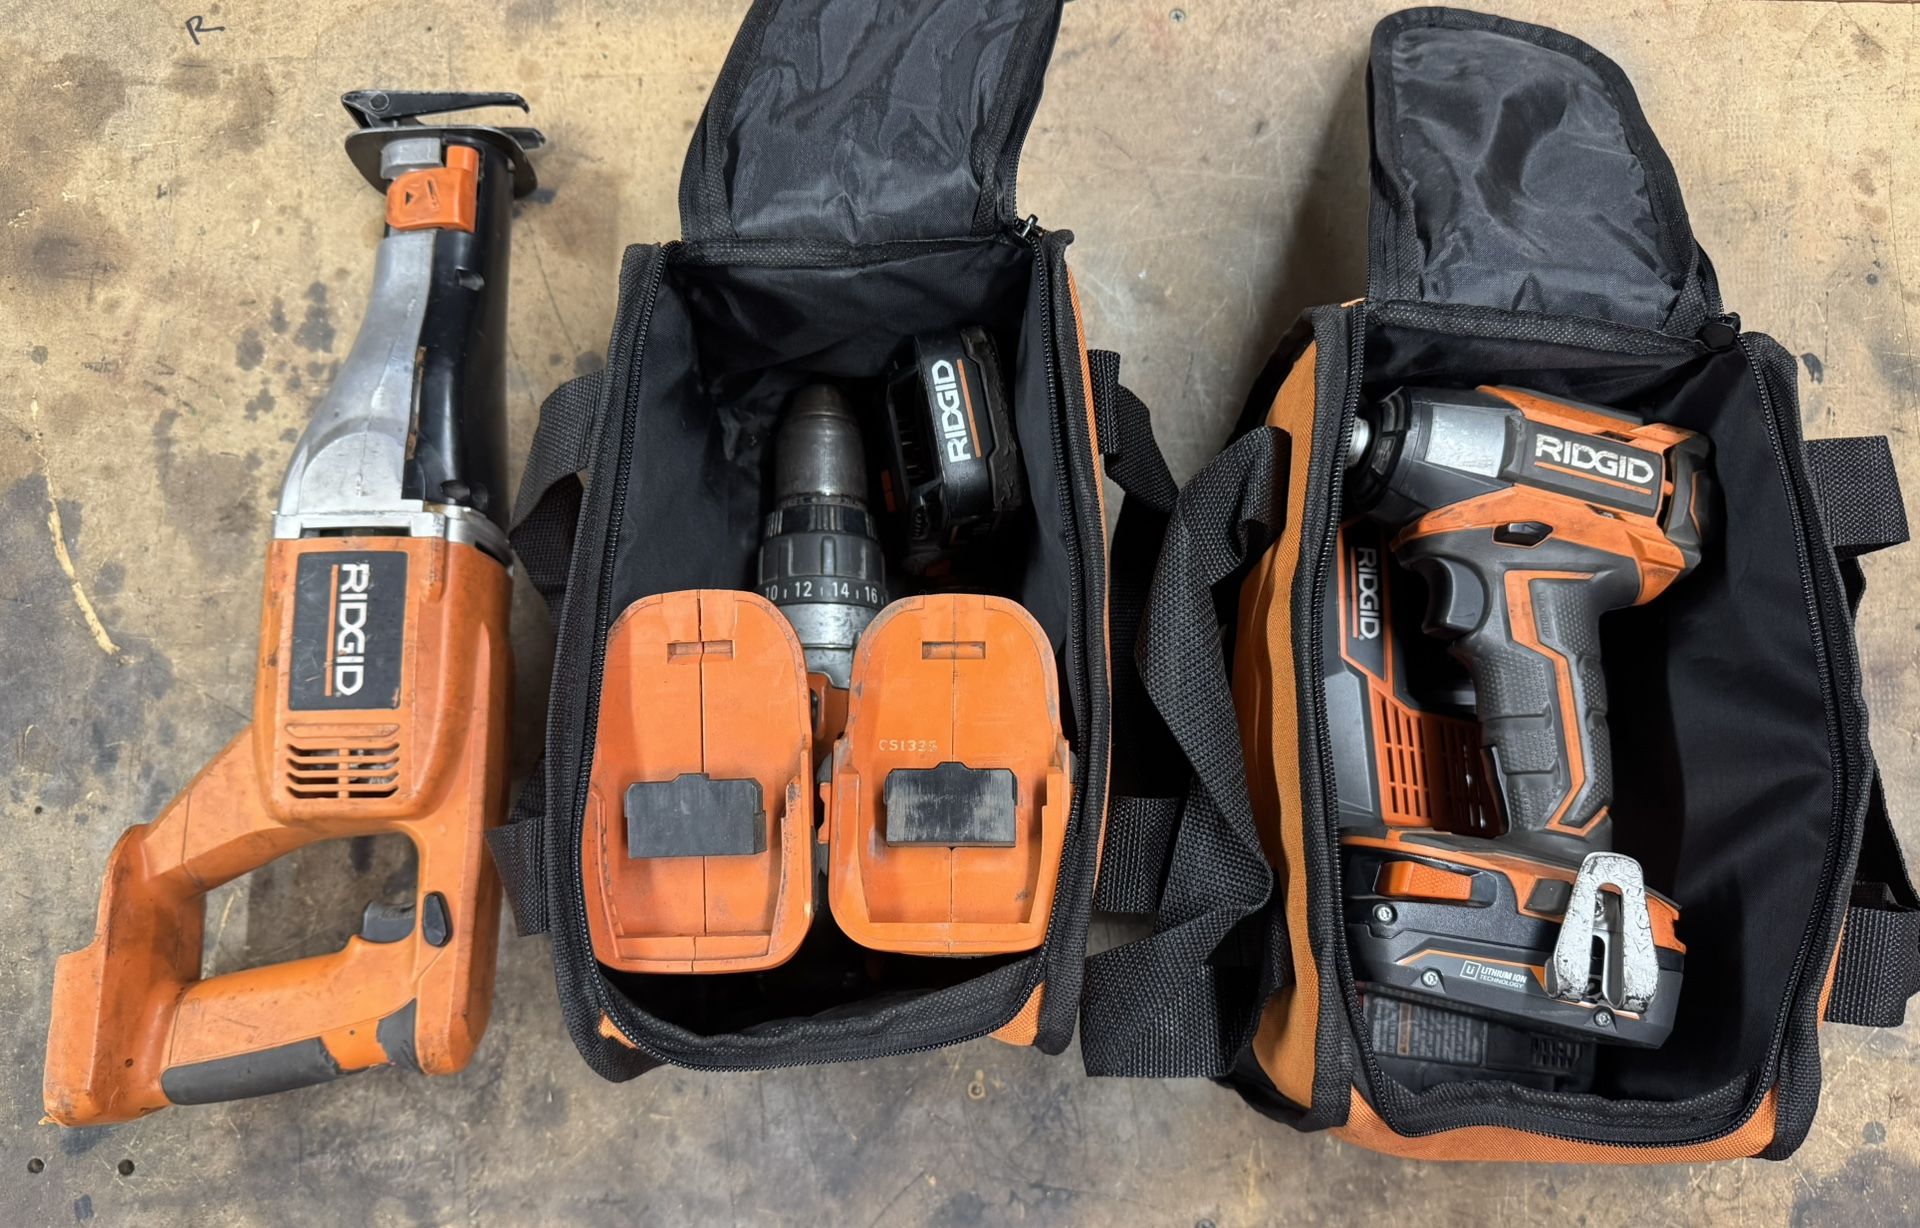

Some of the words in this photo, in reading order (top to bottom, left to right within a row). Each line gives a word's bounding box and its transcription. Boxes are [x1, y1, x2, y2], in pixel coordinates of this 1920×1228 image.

[184, 15, 225, 45] R
[932, 359, 971, 463] RIDGID
[1534, 433, 1654, 484] RIDGID
[765, 585, 778, 601] 10
[795, 581, 813, 598] 12
[831, 581, 850, 598] 14
[864, 586, 878, 604] 16
[1358, 548, 1380, 640] RIDGID
[335, 563, 370, 696] RIDGID
[1479, 974, 1525, 989] TECHNOLOGY
[1480, 966, 1513, 981] LITHIUM
[1512, 974, 1528, 984] ION
